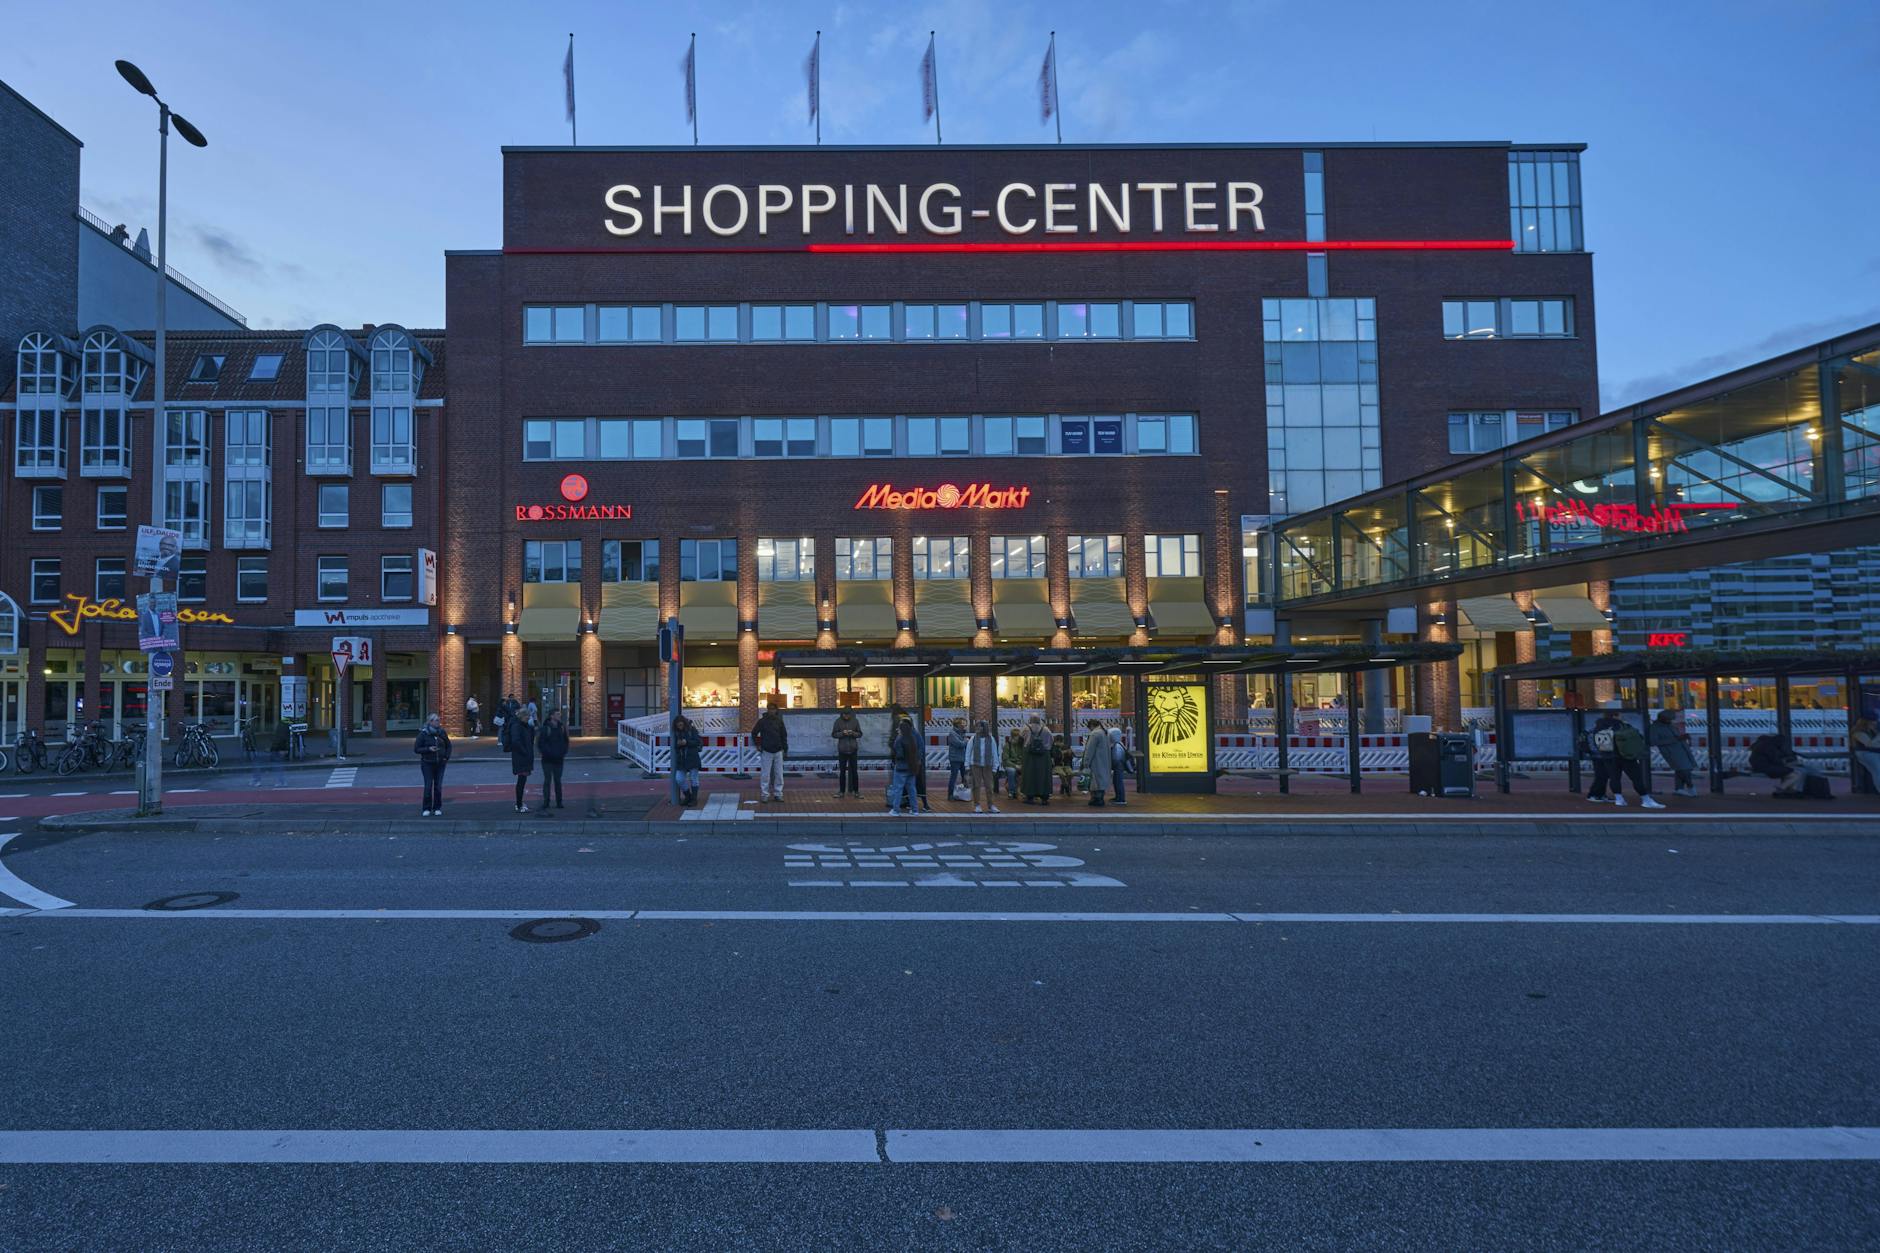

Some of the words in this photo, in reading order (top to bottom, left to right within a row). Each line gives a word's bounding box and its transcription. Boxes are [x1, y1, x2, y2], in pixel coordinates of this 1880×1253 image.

[603, 181, 1266, 237] SHOPPING-CENTER
[515, 505, 632, 520] ROSSMANN
[346, 614, 369, 622] impuls
[1648, 632, 1687, 647] KFC
[153, 679, 172, 688] Ende
